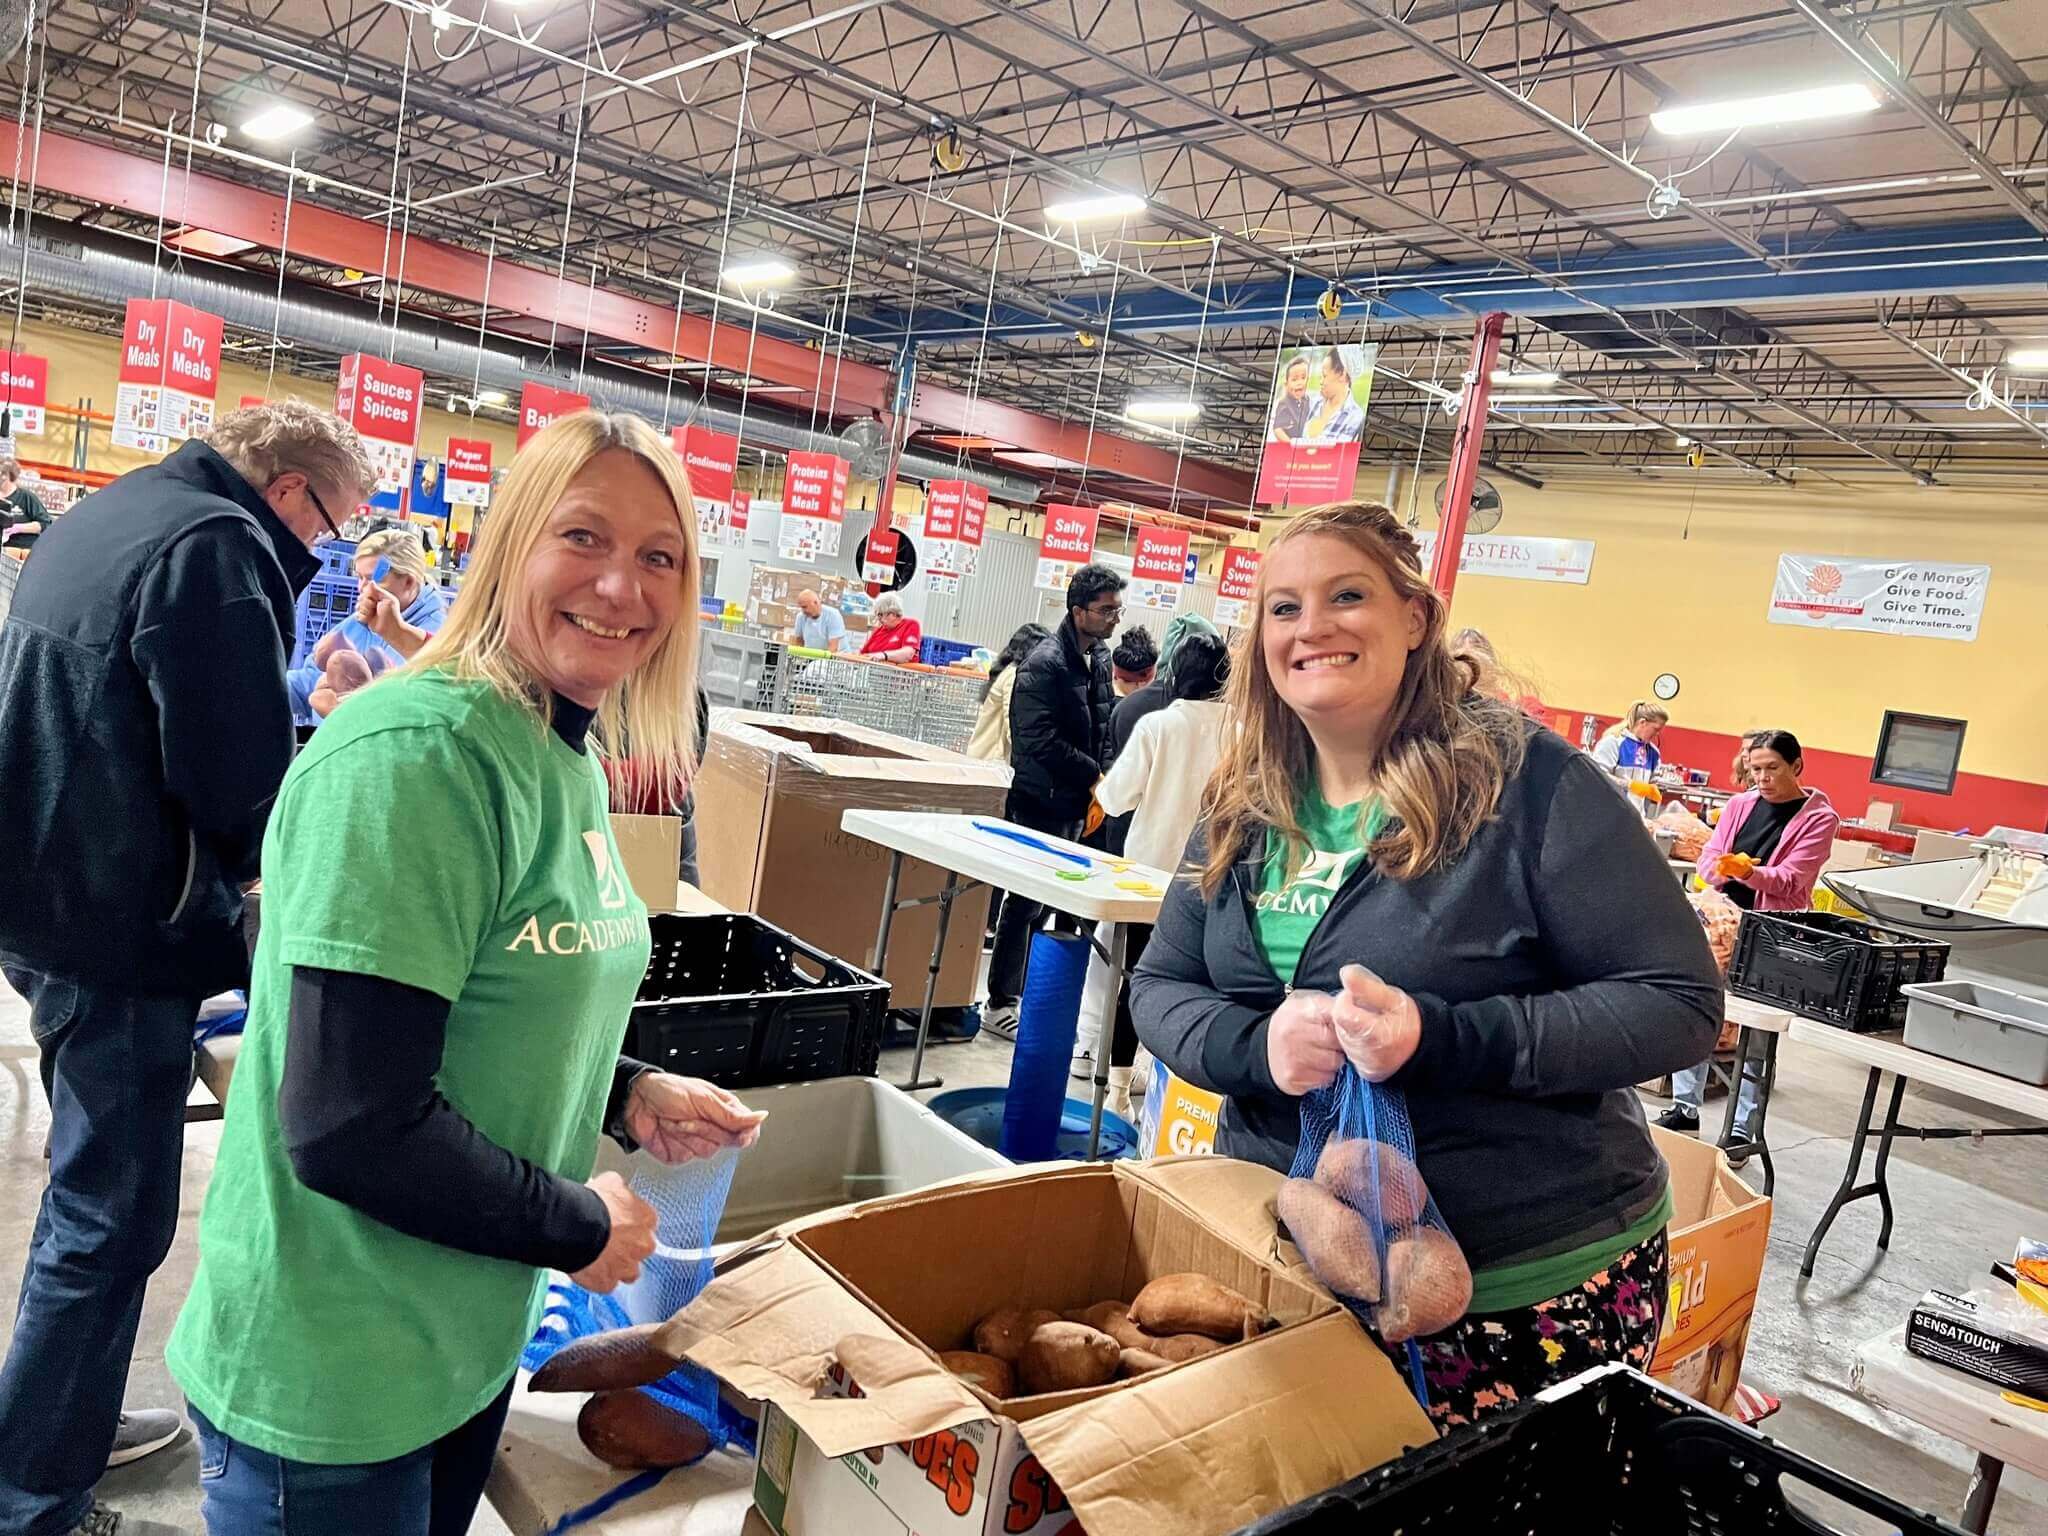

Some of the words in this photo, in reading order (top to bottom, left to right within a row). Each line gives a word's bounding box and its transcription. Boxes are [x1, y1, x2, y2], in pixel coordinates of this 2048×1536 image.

[137, 319, 157, 346] Dry
[183, 327, 205, 357] Dry
[127, 345, 160, 368] Meals
[172, 351, 212, 381] Meals
[363, 372, 413, 402] Sauces
[362, 396, 409, 423] Spices
[456, 448, 482, 463] Paper
[687, 452, 732, 473] Condiments
[449, 459, 489, 473] Products
[791, 463, 829, 481] Proteins
[793, 480, 822, 495] Meats
[791, 495, 820, 511] Meals
[930, 490, 960, 504] Proteins
[929, 520, 953, 533] Meals
[1054, 518, 1087, 538] Salty
[871, 541, 893, 555] Sugar
[1045, 536, 1090, 553] Snacks
[1142, 539, 1182, 558] Sweet
[1137, 556, 1182, 574] Snacks
[1884, 568, 1918, 581] Give
[1922, 571, 1980, 587] Money.
[1887, 584, 1921, 598] Give
[1926, 587, 1969, 601] Food.
[1883, 600, 1917, 613] Give
[1922, 603, 1966, 617] Time.
[1871, 615, 1973, 632] www.harvesters.org
[504, 914, 636, 955] ACADEMY
[1914, 1313, 2002, 1355] SENSATOUCH
[869, 1472, 880, 1491] BY
